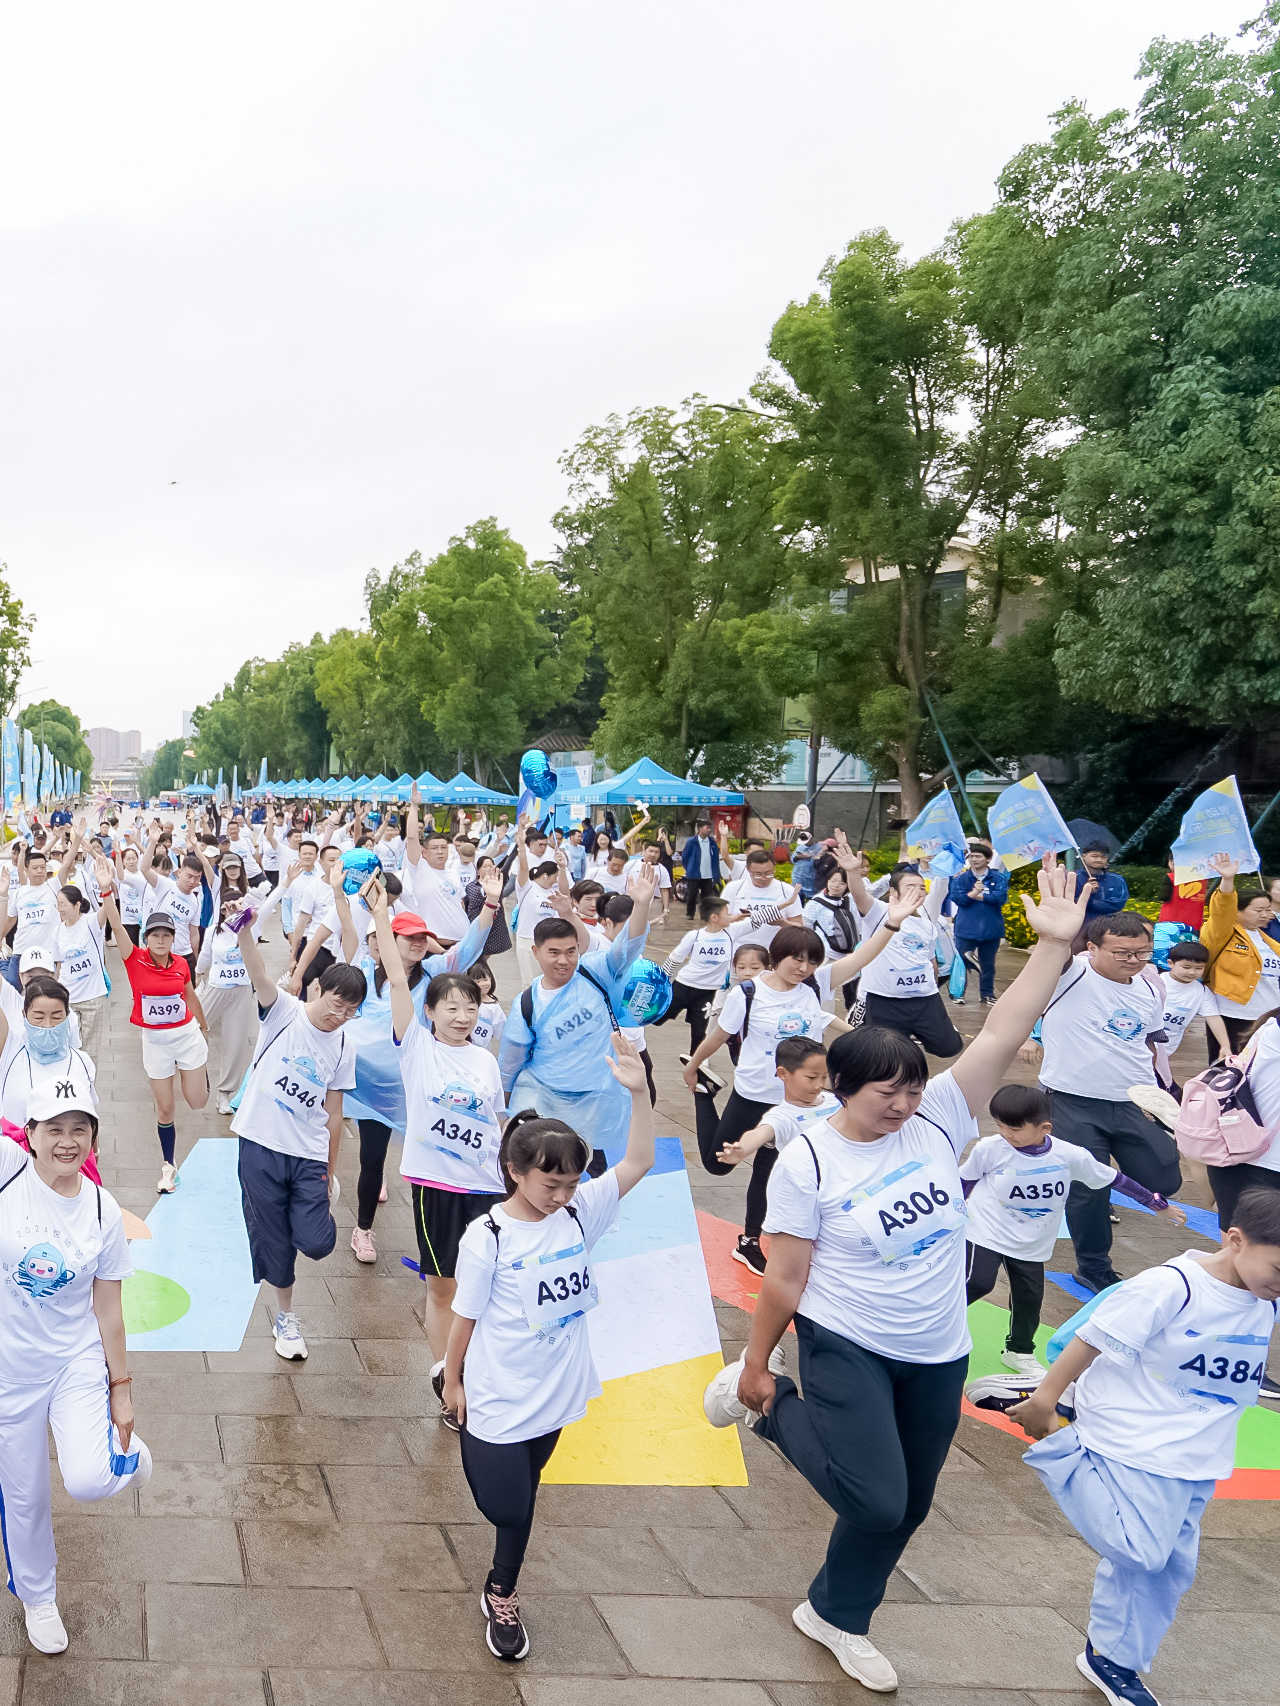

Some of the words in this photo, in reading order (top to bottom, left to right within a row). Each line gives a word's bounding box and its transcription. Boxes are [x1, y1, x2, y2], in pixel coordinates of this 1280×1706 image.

[25, 910, 45, 920] A317
[170, 900, 190, 916] A454
[699, 946, 726, 956] A426
[70, 958, 92, 974] A341
[219, 968, 246, 979] A389
[896, 974, 928, 987] A342
[148, 1003, 180, 1016] A399
[555, 1007, 593, 1040] A328
[474, 1026, 488, 1038] 88
[274, 1075, 318, 1108] A346
[430, 1118, 484, 1149] A345
[1008, 1180, 1065, 1200] A350
[878, 1181, 950, 1237] A306
[538, 1266, 589, 1306] A336
[1179, 1353, 1264, 1386] A384
